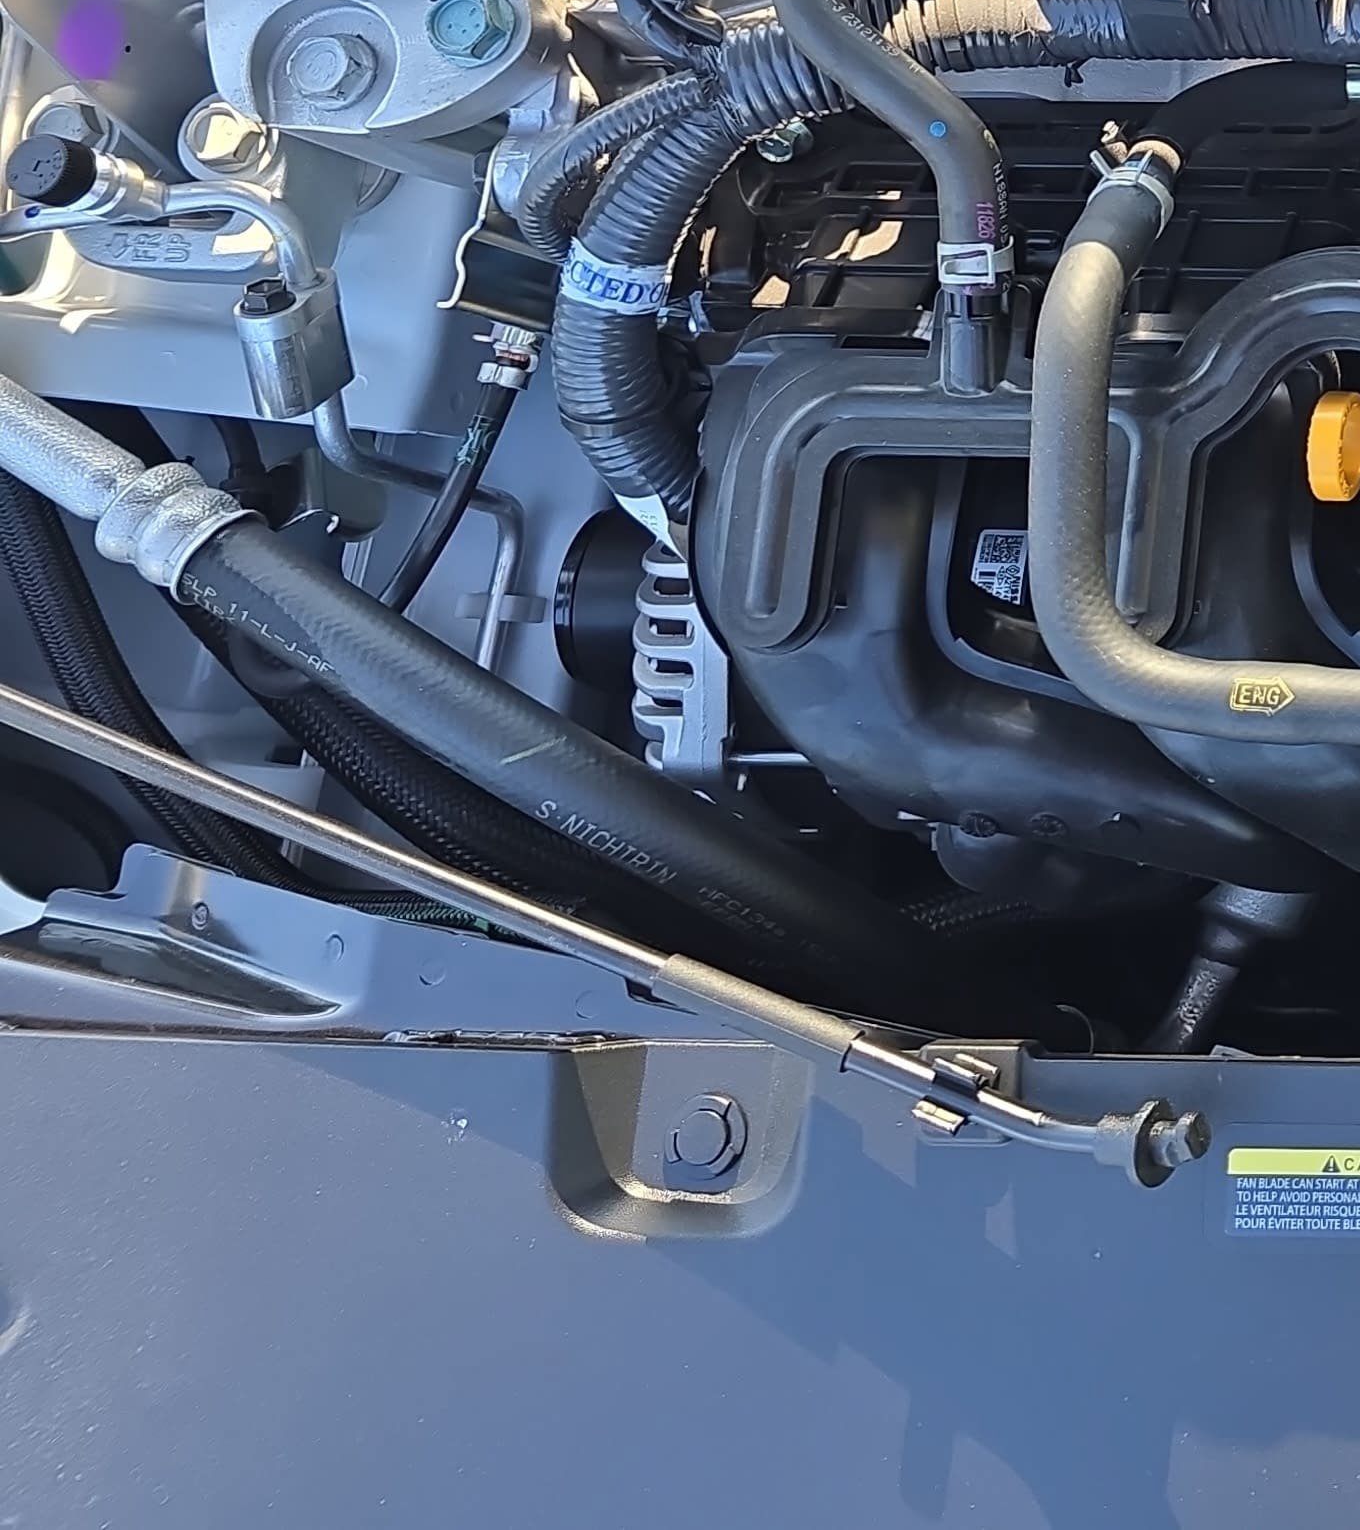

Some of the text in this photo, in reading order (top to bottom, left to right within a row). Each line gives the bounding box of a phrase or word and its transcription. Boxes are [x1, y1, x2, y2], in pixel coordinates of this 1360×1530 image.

[568, 250, 644, 305] CTED
[1237, 681, 1282, 706] ENG
[1236, 1178, 1257, 1189] FAN
[1258, 1178, 1291, 1190] BLADE
[1292, 1178, 1315, 1190] CAN
[1316, 1179, 1346, 1190] START
[1347, 1179, 1360, 1190] AT
[1236, 1191, 1251, 1202] TO
[1253, 1191, 1278, 1203] HELP
[1279, 1192, 1311, 1203] AVOID
[1235, 1204, 1248, 1216] LE
[1250, 1204, 1322, 1217] VENTILATEUR
[1235, 1218, 1266, 1230] POUR
[1268, 1216, 1304, 1230] ÉVITER
[1305, 1218, 1341, 1230] TOUTE
